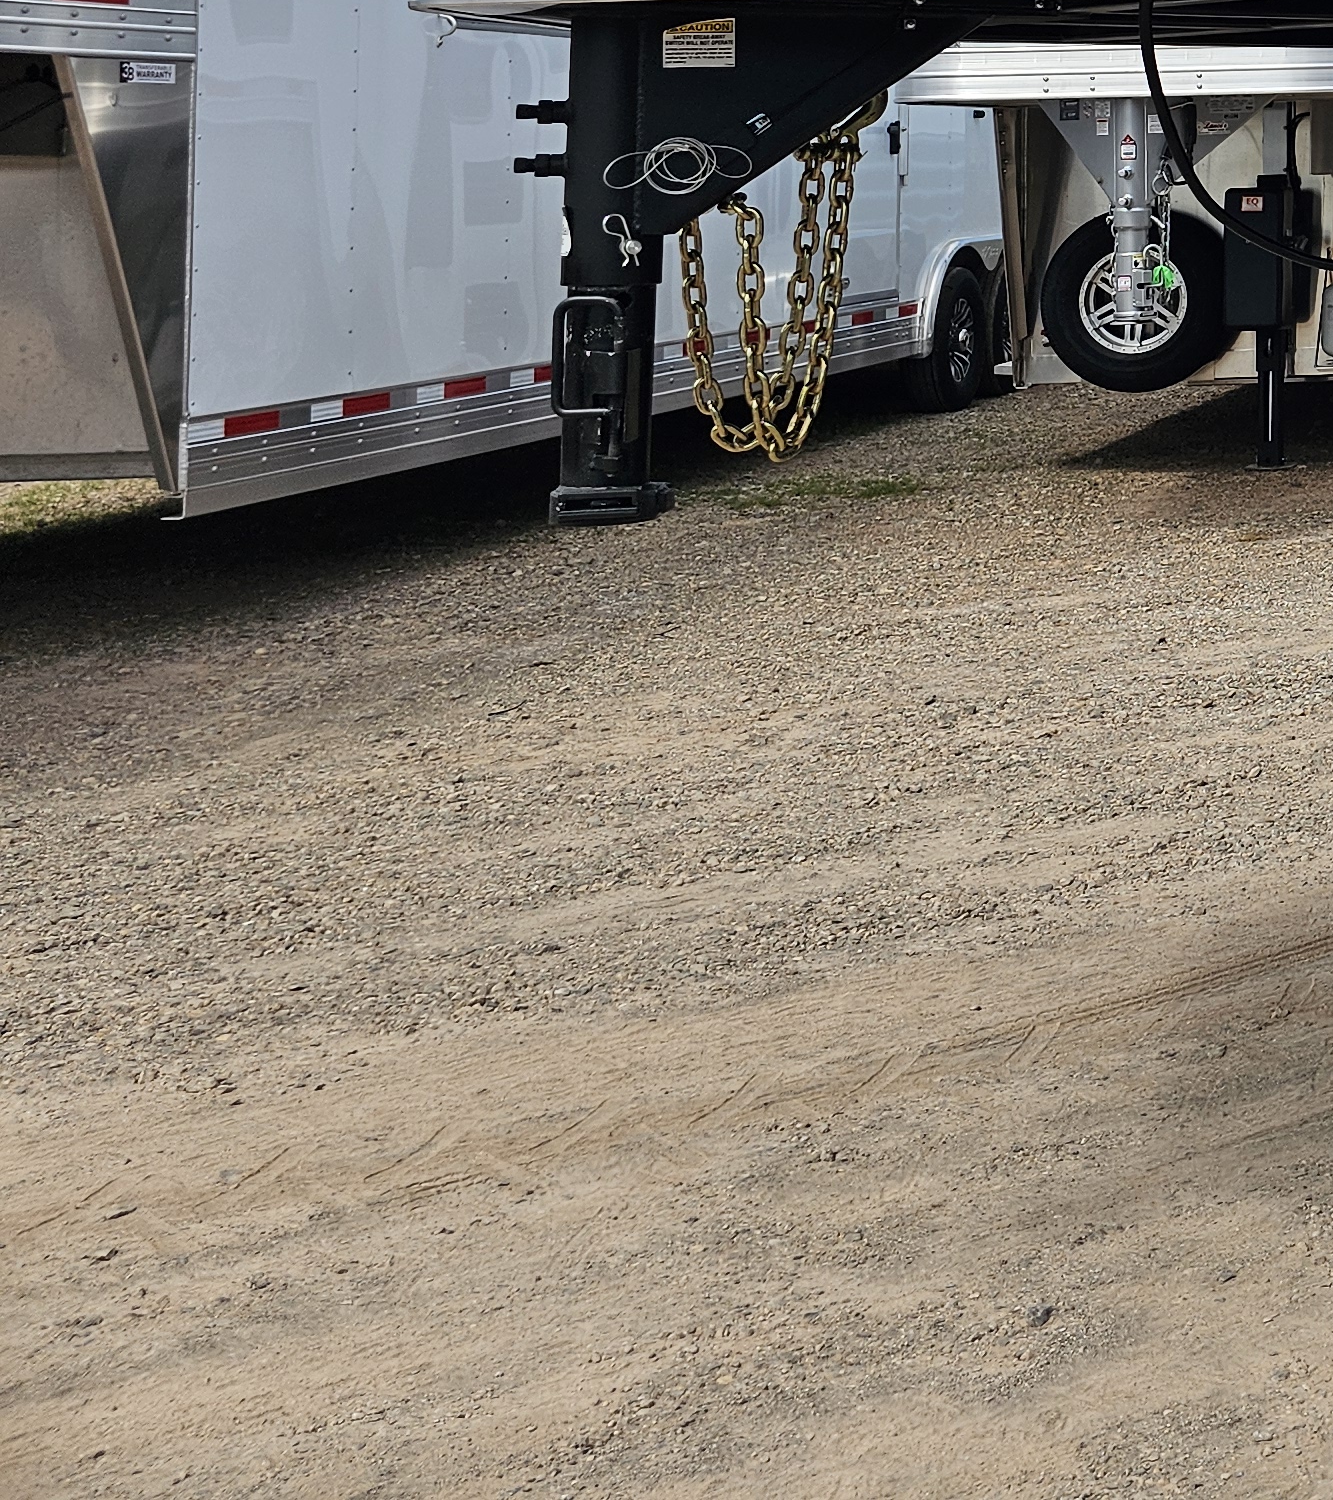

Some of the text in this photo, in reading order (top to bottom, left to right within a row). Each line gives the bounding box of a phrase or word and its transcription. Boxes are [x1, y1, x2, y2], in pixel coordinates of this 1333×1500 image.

[679, 22, 730, 32] CAUTION
[136, 70, 173, 79] WARRANTY
[1247, 197, 1259, 208] EQ
